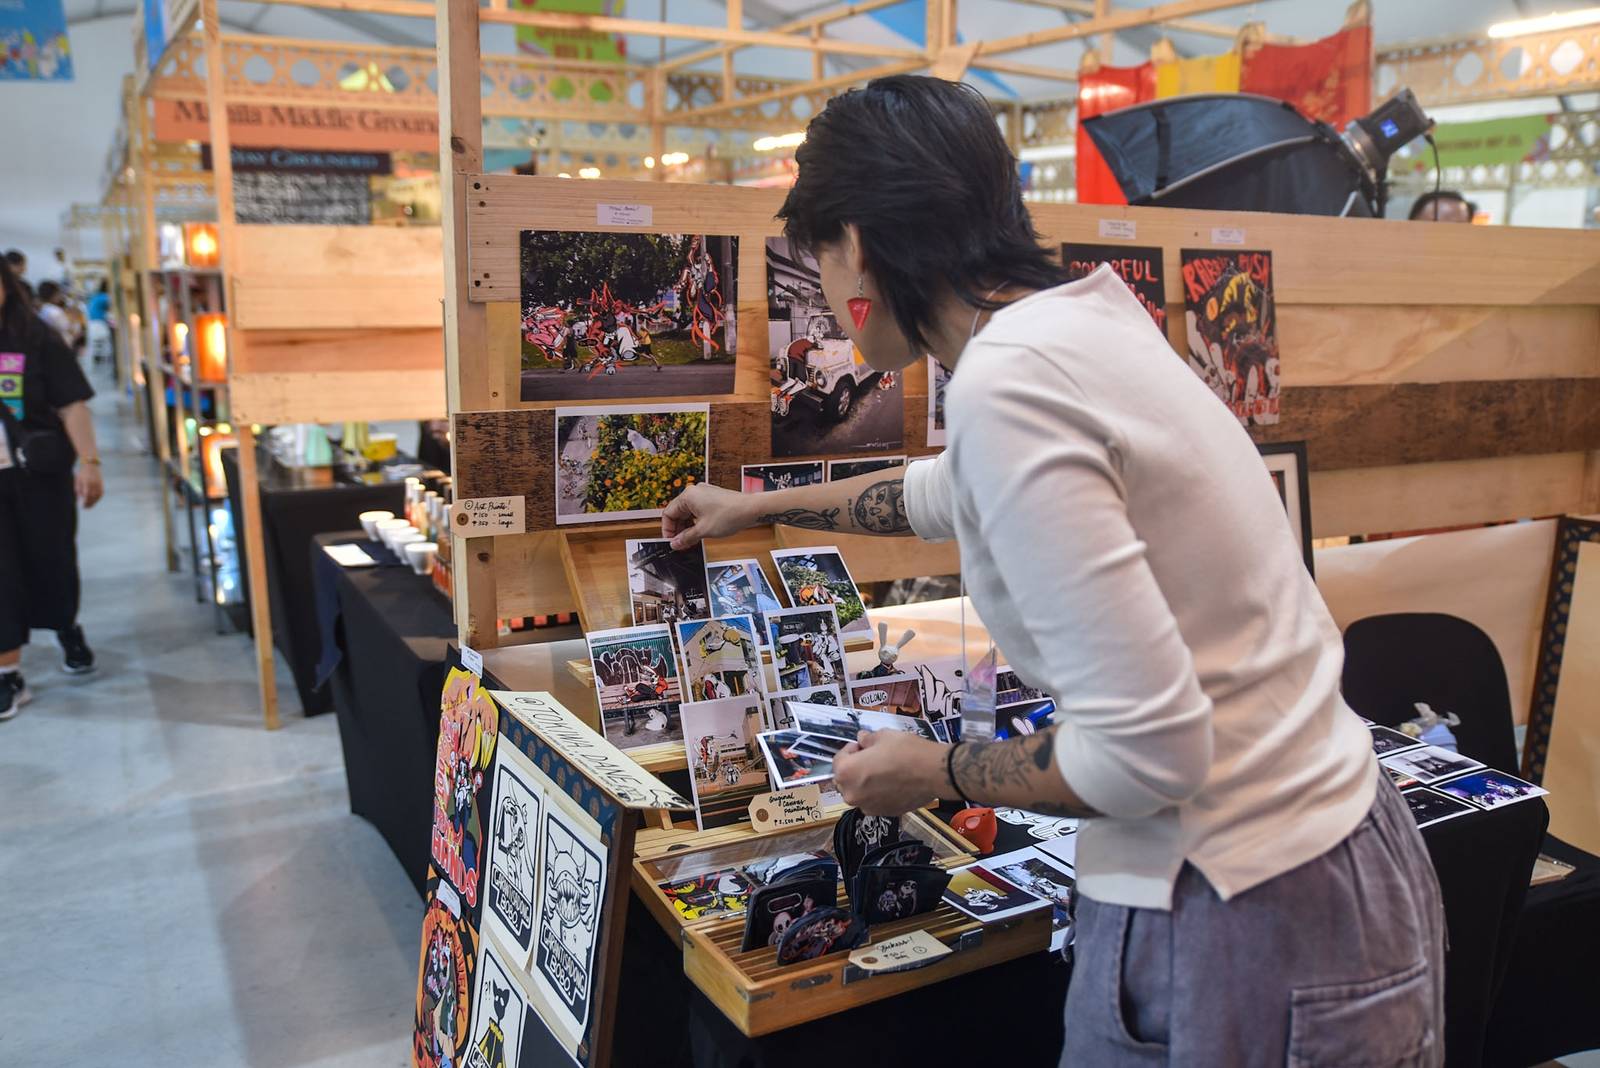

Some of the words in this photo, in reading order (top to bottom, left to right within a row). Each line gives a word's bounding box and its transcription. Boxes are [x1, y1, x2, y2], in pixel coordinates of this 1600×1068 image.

[174, 100, 262, 125] Mnila
[268, 106, 351, 129] Middle
[357, 110, 439, 133] Groun
[1069, 258, 1159, 283] CORFUL
[861, 692, 886, 704] KULONG
[769, 792, 794, 806] Original
[783, 799, 806, 807] Canvas
[431, 823, 478, 908] HANDS
[500, 893, 519, 929] BOBO.
[549, 954, 572, 997] BOBO.
